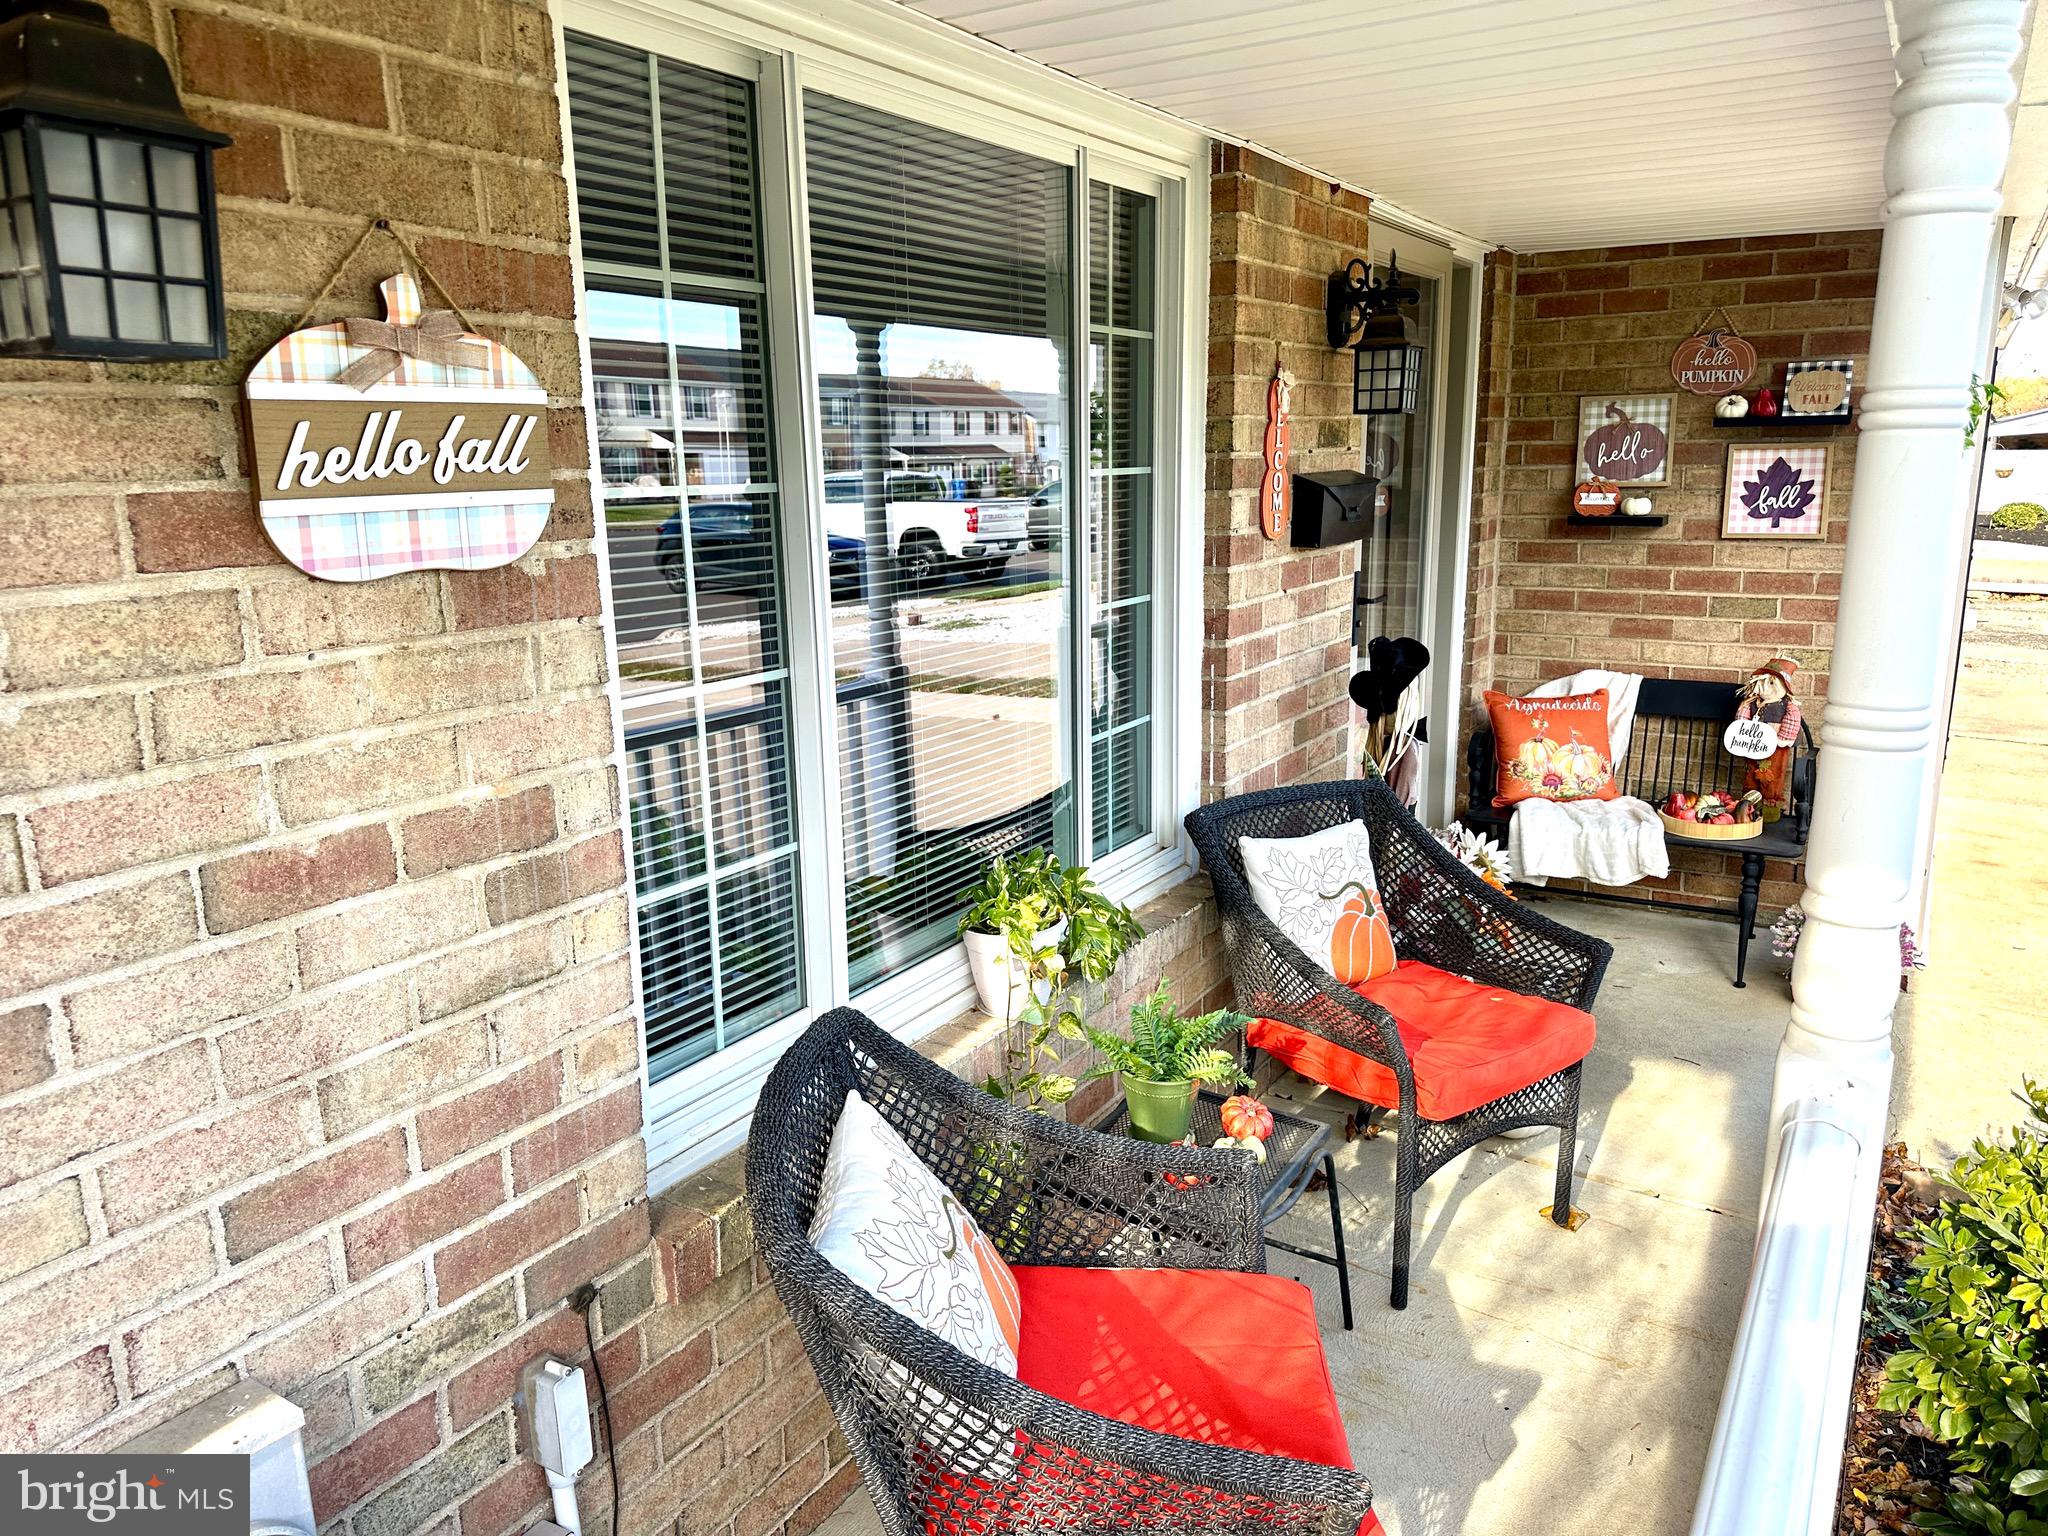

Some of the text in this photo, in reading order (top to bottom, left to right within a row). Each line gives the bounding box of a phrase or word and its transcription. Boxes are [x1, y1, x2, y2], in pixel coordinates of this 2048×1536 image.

[1690, 349, 1735, 366] hello
[1681, 369, 1745, 384] PUMPKIN
[1794, 380, 1842, 392] Welcome
[1802, 394, 1830, 405] FALL
[276, 410, 538, 491] hello fall
[1597, 431, 1654, 468] hello
[1750, 485, 1801, 515] fall
[1505, 697, 1602, 715] Agradecido
[1739, 722, 1764, 739] hello
[1730, 736, 1769, 753] pumpkin
